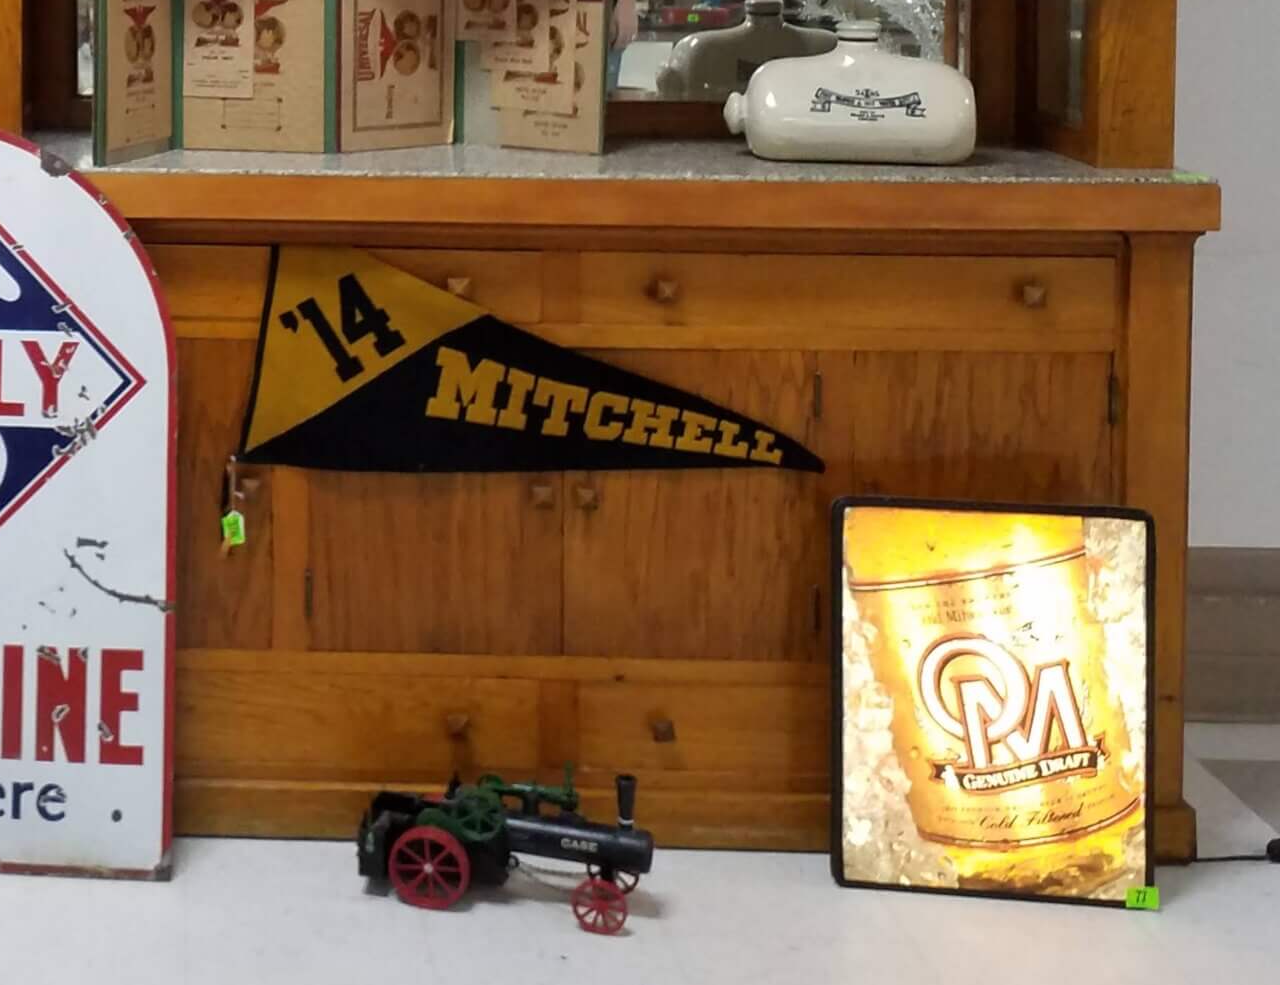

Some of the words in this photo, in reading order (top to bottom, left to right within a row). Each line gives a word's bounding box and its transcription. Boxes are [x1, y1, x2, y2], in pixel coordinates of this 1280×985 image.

[278, 272, 407, 384] '14
[425, 346, 784, 465] MITCHELL
[962, 766, 1039, 790] GENUINE
[1039, 753, 1091, 777] DRAFT
[978, 814, 1019, 830] Cold
[560, 837, 599, 853] CASE
